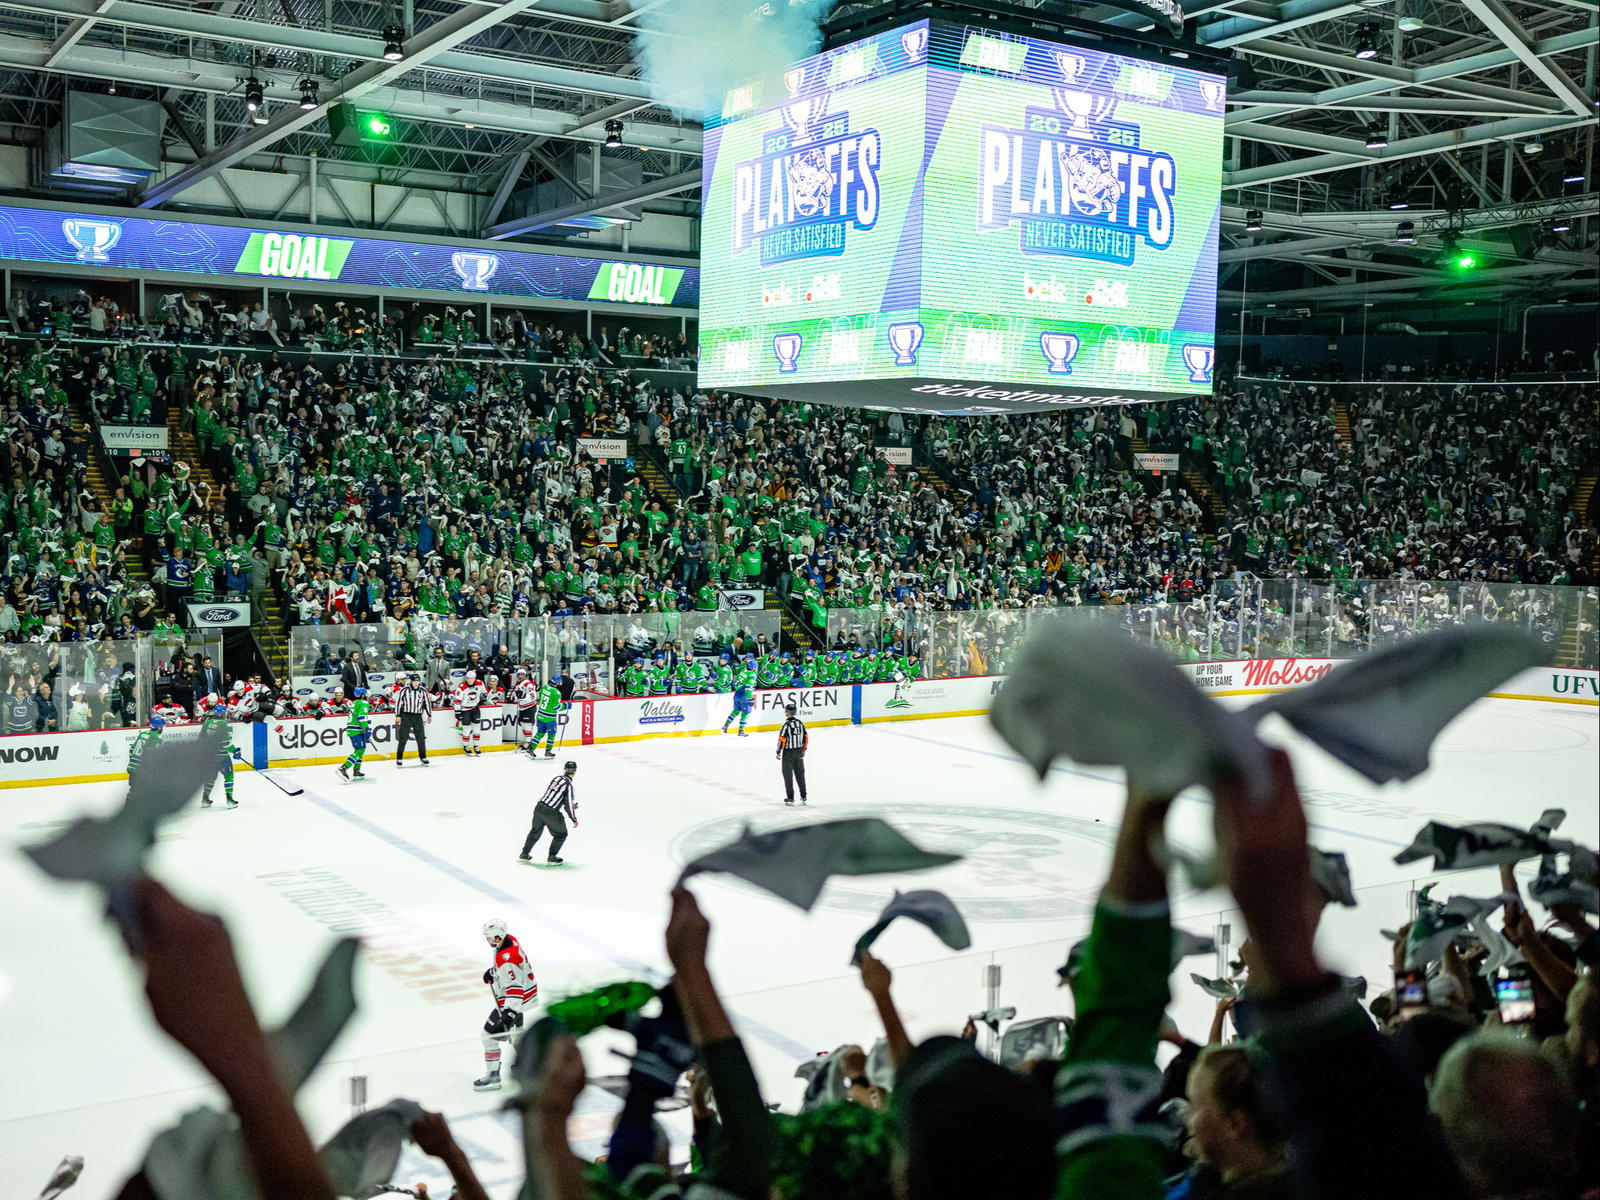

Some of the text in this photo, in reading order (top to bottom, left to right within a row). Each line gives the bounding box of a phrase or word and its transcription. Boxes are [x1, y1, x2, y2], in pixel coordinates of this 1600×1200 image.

[1029, 114, 1136, 146] 20 25
[766, 135, 787, 152] 20
[735, 133, 879, 248] PLAYFFS
[983, 131, 1174, 245] PLAYFFS
[763, 223, 842, 259] NEVER SATISFIED
[1026, 222, 1132, 259] NEVER SATISFIED
[260, 232, 331, 280] GOAL
[608, 262, 666, 304] GOAL
[731, 595, 751, 605] Ford
[206, 609, 232, 621] Ford
[1196, 664, 1223, 675] UP YOUR
[1196, 675, 1233, 688] HOME GAME
[1242, 658, 1332, 687] Molson
[761, 689, 837, 710] FASKEN
[481, 718, 503, 731] DP
[640, 700, 683, 725] Valley
[280, 724, 348, 749] Uber
[508, 970, 516, 981] 3
